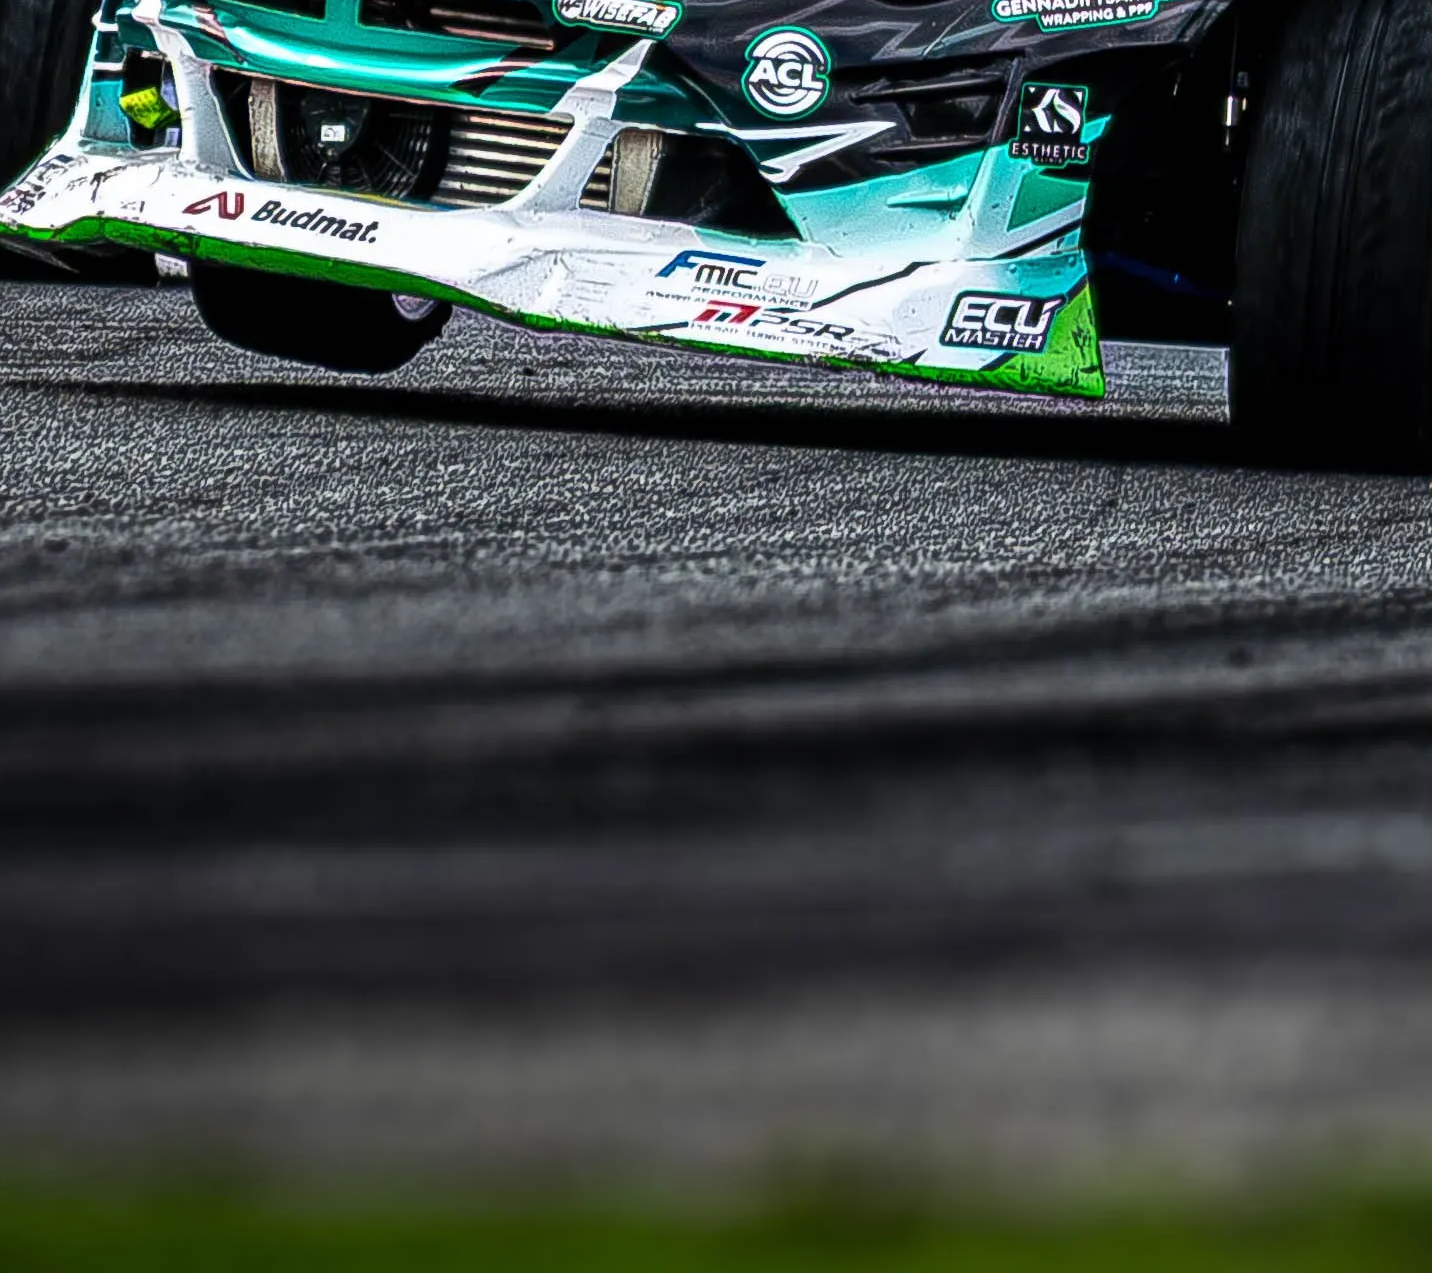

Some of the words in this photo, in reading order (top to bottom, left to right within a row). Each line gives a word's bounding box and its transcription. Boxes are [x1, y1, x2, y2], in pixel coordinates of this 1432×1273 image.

[1041, 7, 1114, 27] WRAPPING
[1116, 6, 1127, 19] &
[749, 59, 824, 90] ACL
[1012, 142, 1086, 159] ESTHETIC
[749, 312, 855, 342] PSR
[952, 296, 1063, 335] ECU
[944, 328, 1043, 350] MASTER
